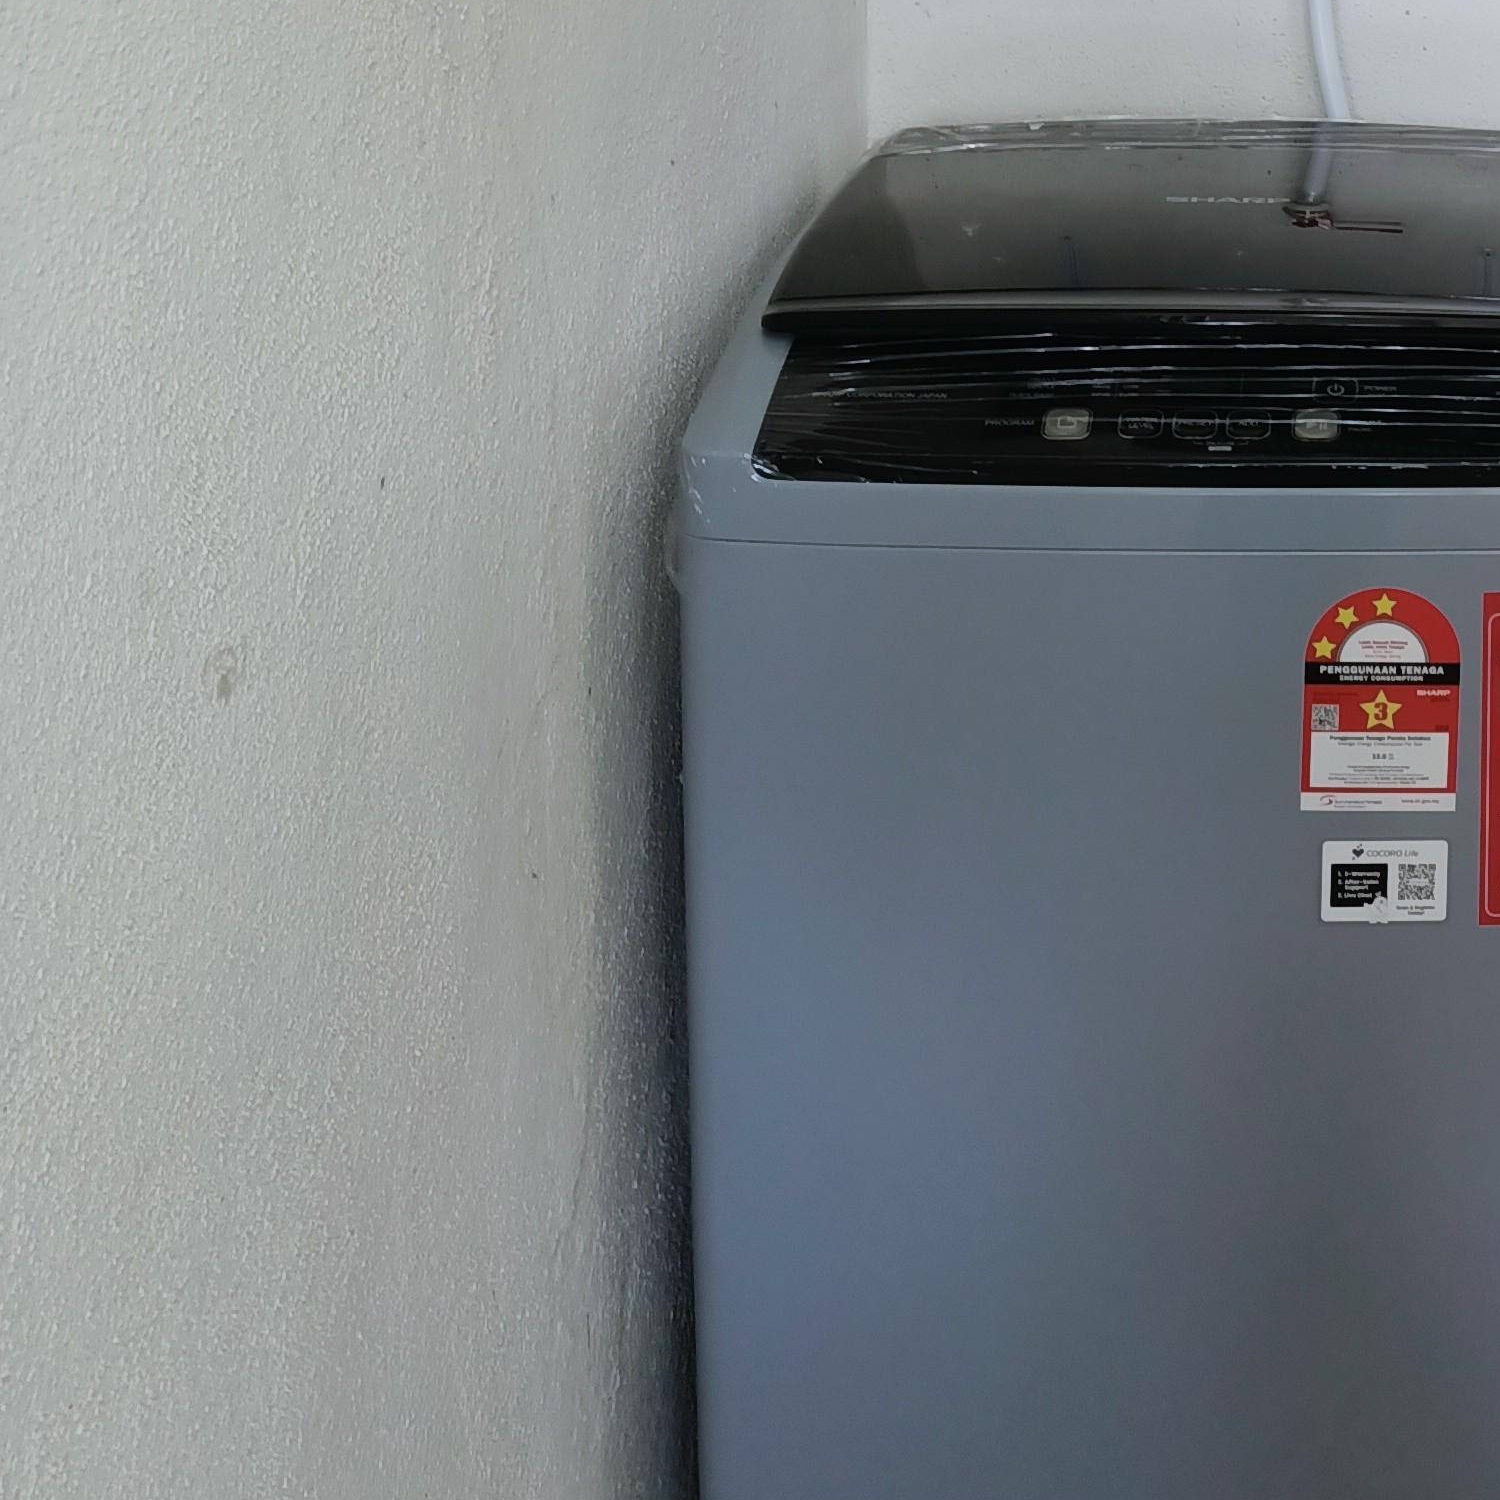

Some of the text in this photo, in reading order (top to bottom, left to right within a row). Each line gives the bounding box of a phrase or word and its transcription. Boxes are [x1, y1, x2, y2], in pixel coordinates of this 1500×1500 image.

[1319, 665, 1445, 675] PENGGUNAAN TENAGA
[1373, 702, 1389, 722] 3
